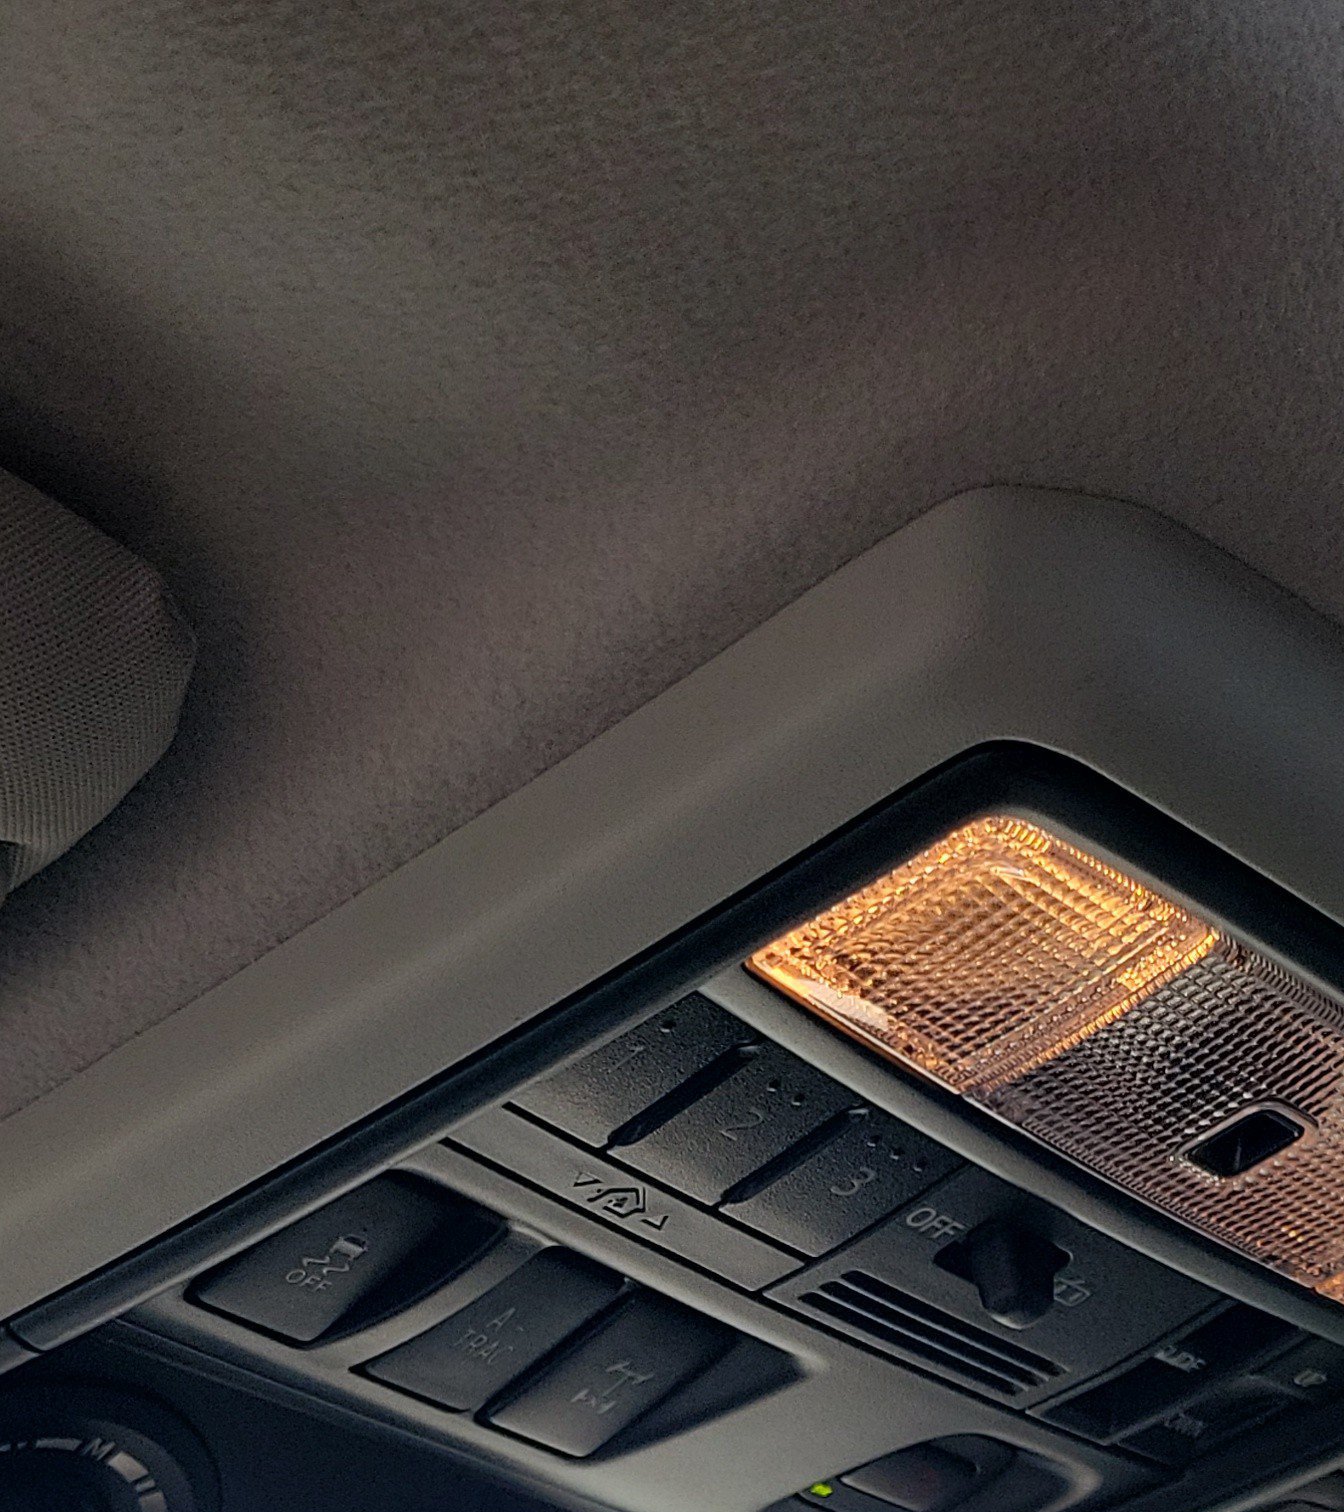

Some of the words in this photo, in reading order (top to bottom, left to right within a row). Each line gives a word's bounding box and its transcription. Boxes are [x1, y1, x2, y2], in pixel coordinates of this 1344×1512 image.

[719, 1105, 767, 1141] 2
[829, 1165, 878, 1197] 3
[904, 1206, 969, 1240] OFF
[284, 1267, 334, 1294] OFF
